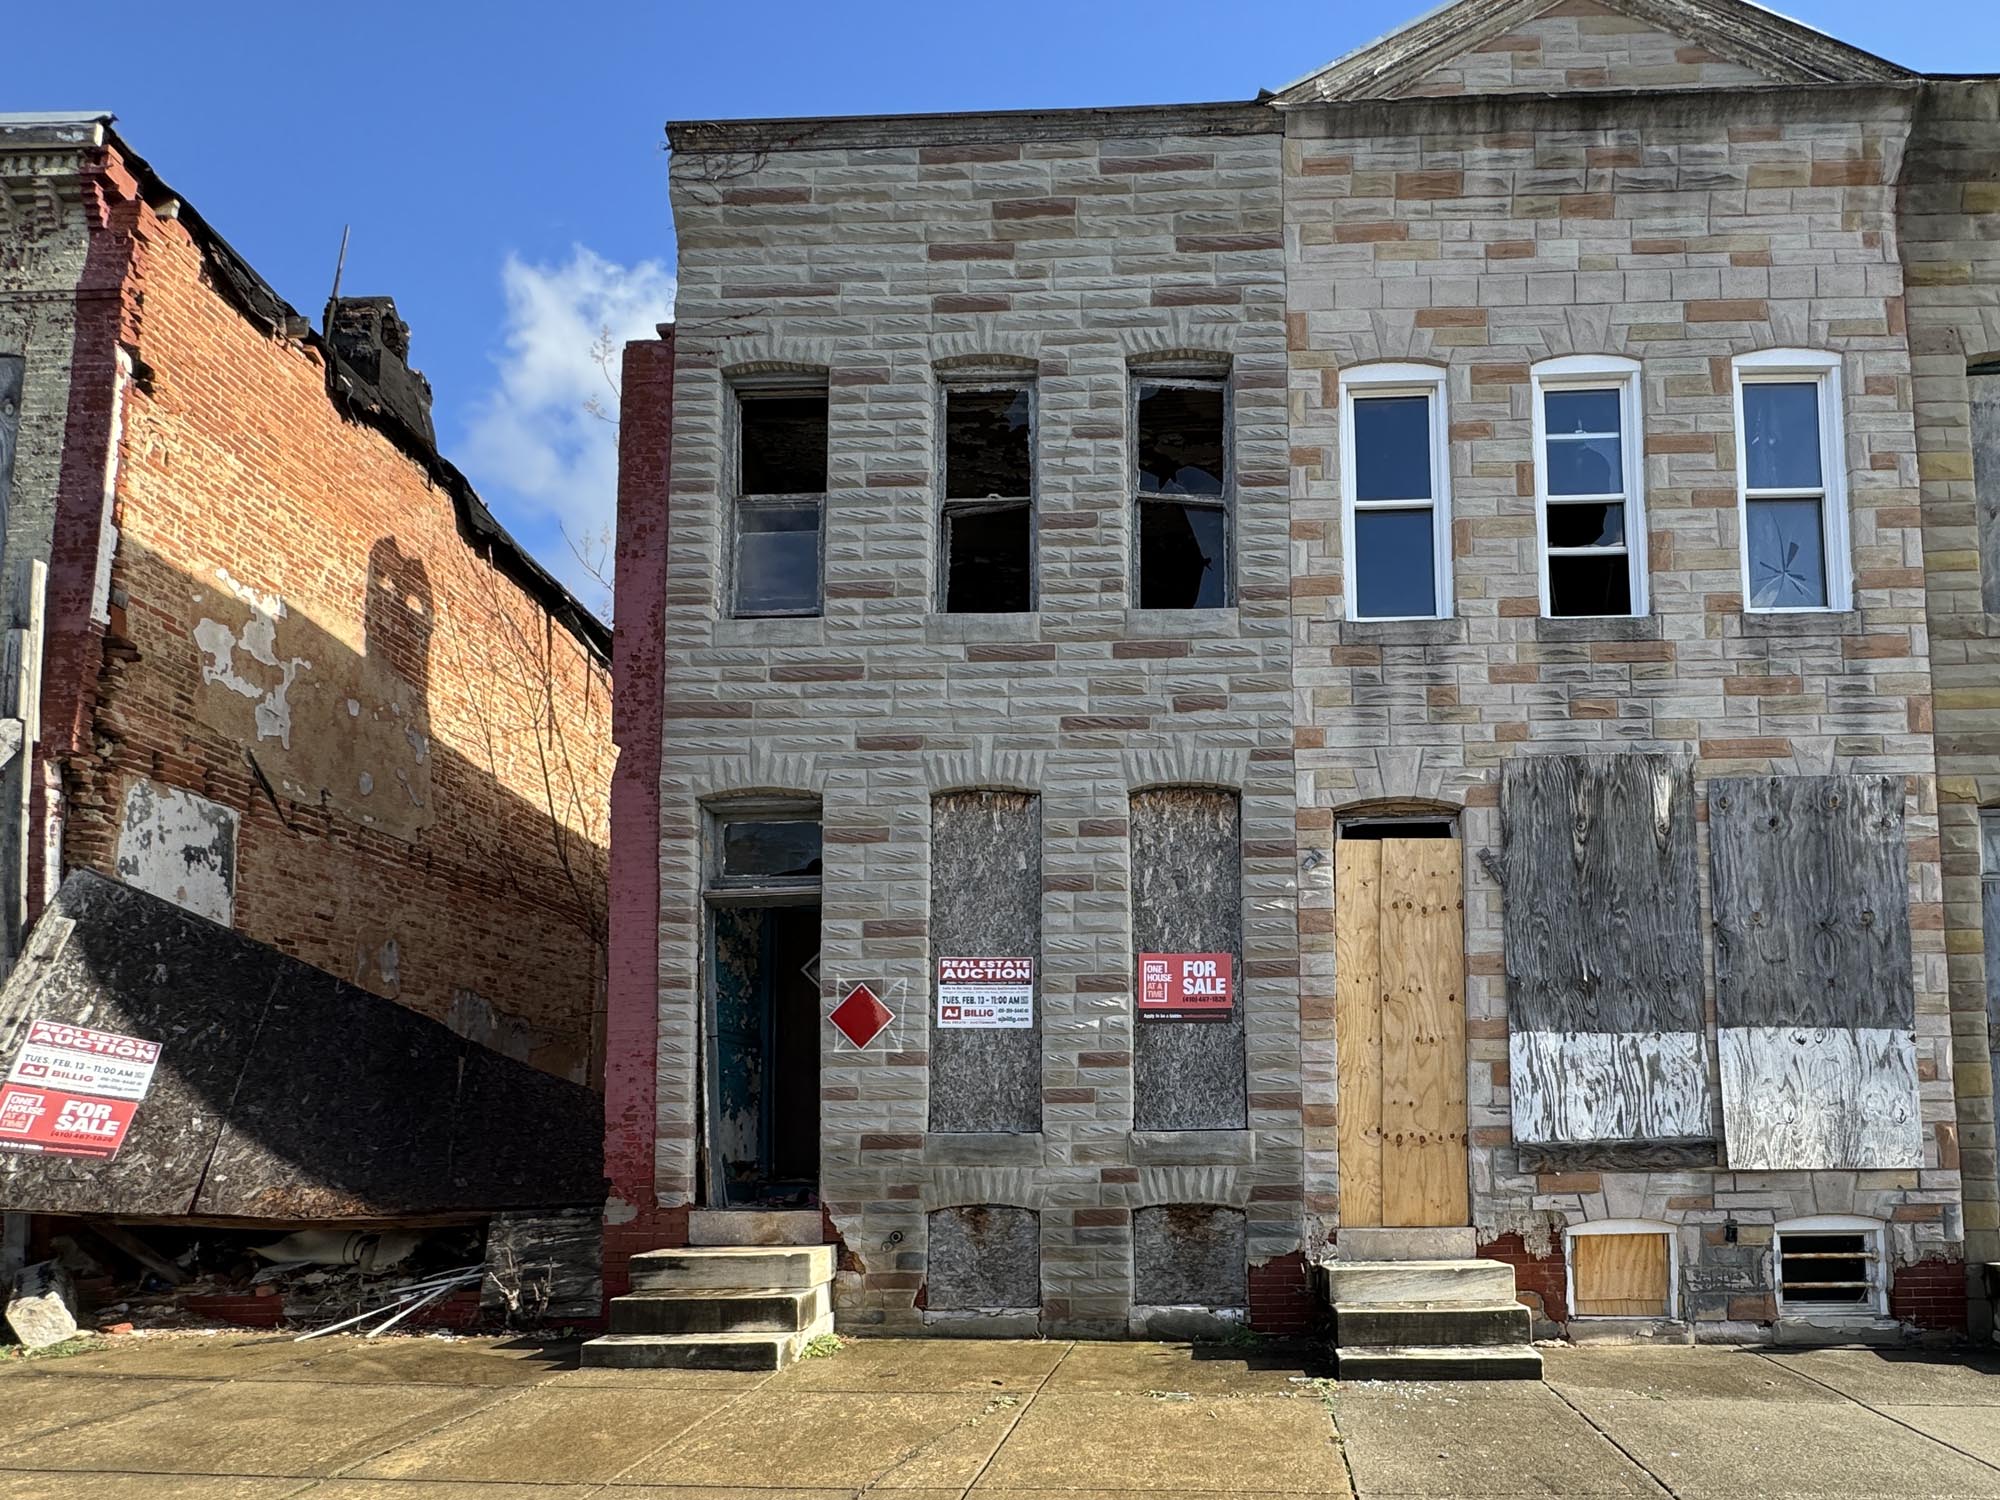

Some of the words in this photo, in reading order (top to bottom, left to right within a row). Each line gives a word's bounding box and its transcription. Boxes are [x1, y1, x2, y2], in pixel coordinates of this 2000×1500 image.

[942, 960, 976, 968] REAL
[979, 960, 1030, 968] ESTATE
[1147, 964, 1163, 973] ONE
[1183, 960, 1216, 977] FOR
[942, 968, 1030, 979] AUCTION
[1147, 973, 1172, 982] HOUSE
[1148, 982, 1156, 990] AT
[1157, 982, 1163, 990] A
[1182, 977, 1226, 995] SALE
[1148, 990, 1163, 998] TIME
[942, 996, 961, 1004] TUES.
[962, 996, 976, 1004] FEB.
[978, 996, 984, 1004] 13
[1008, 996, 1020, 1004] AM
[944, 1008, 959, 1017] AJ
[964, 1009, 994, 1017] BILLIG
[36, 1023, 85, 1037] REAL
[87, 1033, 157, 1051] ESTATE
[31, 1031, 155, 1060] AUCTION
[25, 1054, 50, 1064] TUES.
[53, 1058, 72, 1068] FEB.
[75, 1062, 85, 1070] 13
[22, 1065, 45, 1075] AJ
[51, 1070, 94, 1082] BILLIG
[10, 1096, 36, 1106] ONE
[7, 1103, 46, 1116] HOUSE
[61, 1100, 113, 1120] FOR
[3, 1112, 16, 1120] AT
[18, 1113, 26, 1121] A
[1, 1119, 25, 1128] TIME
[54, 1115, 120, 1136] SALE
